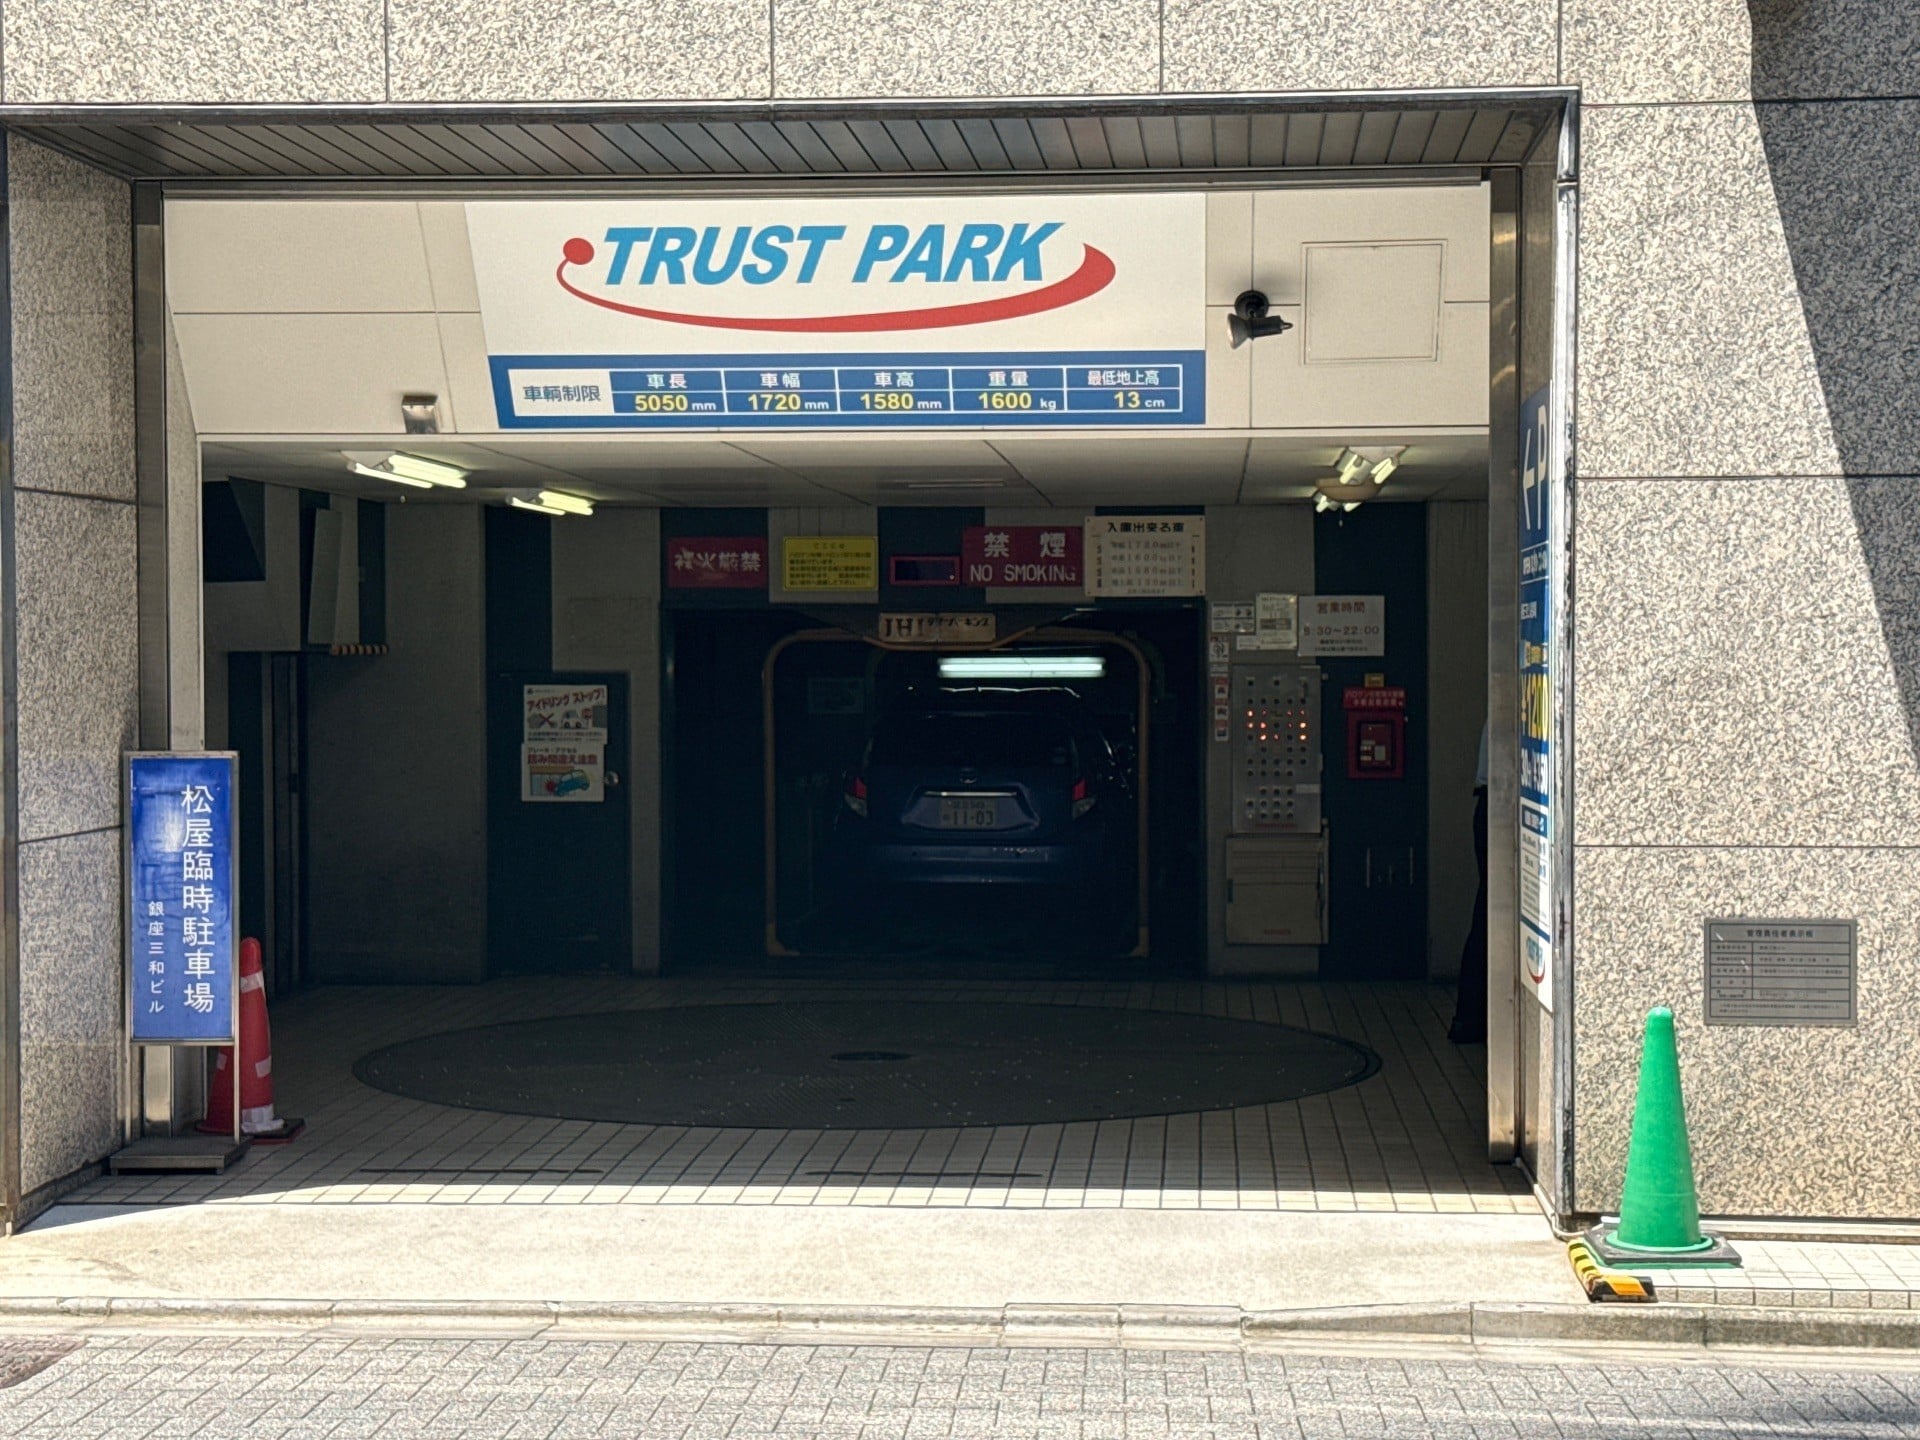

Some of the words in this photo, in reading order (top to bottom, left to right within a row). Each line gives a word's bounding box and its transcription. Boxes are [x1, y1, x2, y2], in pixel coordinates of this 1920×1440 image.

[603, 225, 846, 286] TRUST
[855, 221, 1065, 285] PARK
[647, 372, 687, 390] 車長
[760, 371, 801, 389] 車幅
[874, 371, 914, 389] 車高
[988, 370, 1029, 388] 重量
[1087, 369, 1160, 387] 最低地上高
[634, 392, 688, 412] 5050
[691, 401, 717, 412] mm
[747, 392, 801, 411] 1720
[804, 401, 830, 411] mm
[860, 391, 914, 411] 1580
[916, 400, 943, 411] mm
[978, 391, 1032, 410] 1600
[1040, 398, 1057, 411] kg
[1113, 390, 1140, 410] 13
[1144, 400, 1166, 409] cm
[1537, 404, 1548, 531] P
[984, 532, 1067, 558] 禁煙
[969, 563, 993, 582] NO
[1316, 600, 1366, 614] 営業時間
[180, 784, 216, 1014] 松屋臨時駐車場
[148, 900, 165, 1014] 銀座三和ビル
